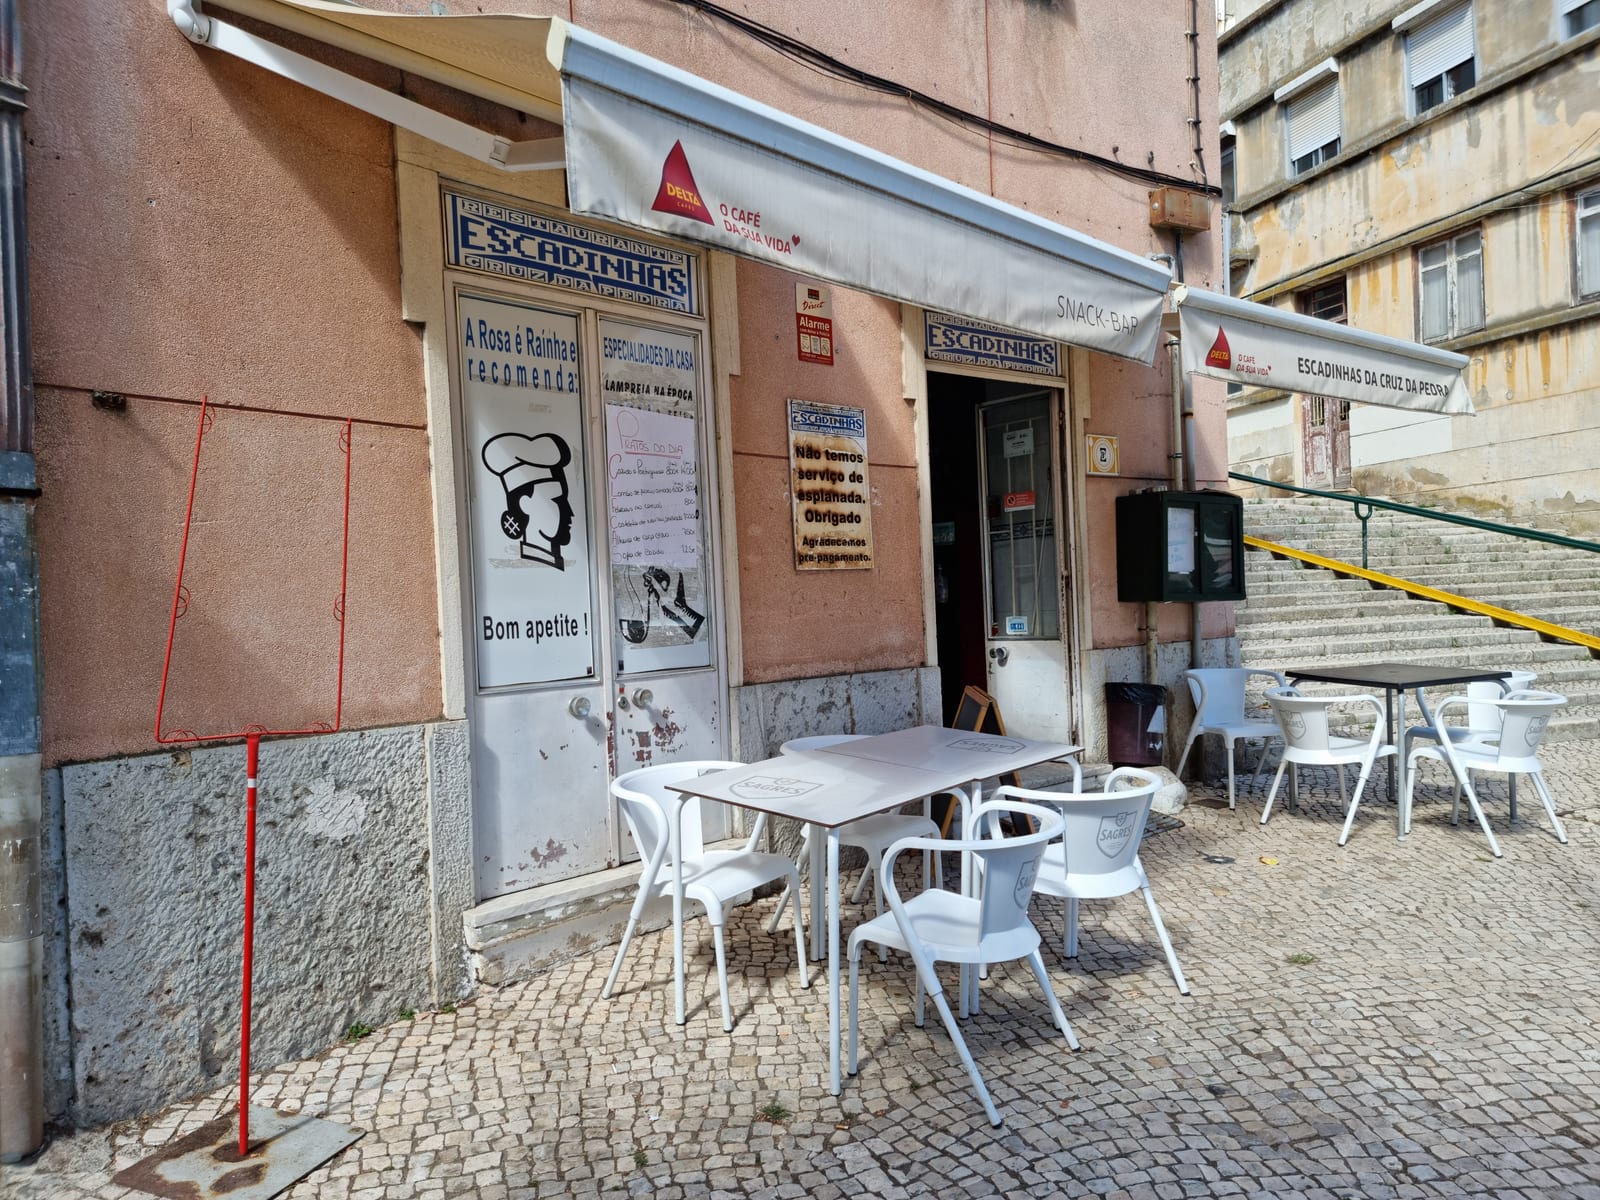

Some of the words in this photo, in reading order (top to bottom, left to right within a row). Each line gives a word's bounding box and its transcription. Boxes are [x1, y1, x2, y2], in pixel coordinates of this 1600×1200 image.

[666, 182, 701, 207] DELTA
[720, 204, 728, 216] O
[731, 208, 760, 228] CAFÉ
[463, 201, 684, 264] RESTAURANTE
[724, 220, 740, 235] DA
[741, 227, 762, 245] SUA
[765, 235, 791, 254] VIDA
[461, 215, 687, 297] ESCADINHAS
[465, 256, 548, 282] CRUZ
[556, 274, 592, 293] DA
[600, 285, 686, 311] PEDRA
[800, 316, 830, 331] Alarme
[1057, 295, 1138, 336] SNACK-BAR
[466, 317, 475, 348] A
[479, 319, 511, 353] Rosa
[515, 325, 522, 354] é
[570, 341, 576, 363] e
[929, 324, 1054, 364] ESCADINHAS
[604, 337, 663, 367] ESPECIALIDADES
[665, 347, 675, 369] DA
[676, 350, 694, 371] CASA
[931, 352, 974, 364] CRUZ
[1211, 351, 1229, 360] DELTA
[1298, 357, 1361, 384] ESCADINHAS
[1365, 370, 1377, 387] DA
[1380, 373, 1403, 391] CRUZ
[1406, 378, 1417, 394] DA
[1419, 381, 1449, 398] PEDRA
[605, 380, 650, 395] LAMPREIA
[654, 385, 665, 396] NA
[668, 384, 692, 401] ÉPOCA
[792, 411, 863, 430] ESCADINHAS
[796, 445, 821, 460] Não
[825, 449, 863, 464] temos
[798, 468, 845, 485] serviço
[849, 470, 863, 483] de
[798, 489, 866, 505] esplanada.
[805, 509, 861, 526] Obrigado
[802, 536, 866, 548] Agradecemos
[483, 616, 519, 641] Bom
[526, 613, 578, 644] apetite
[738, 781, 805, 795] SAGRES
[1100, 825, 1132, 841] SAGRES
